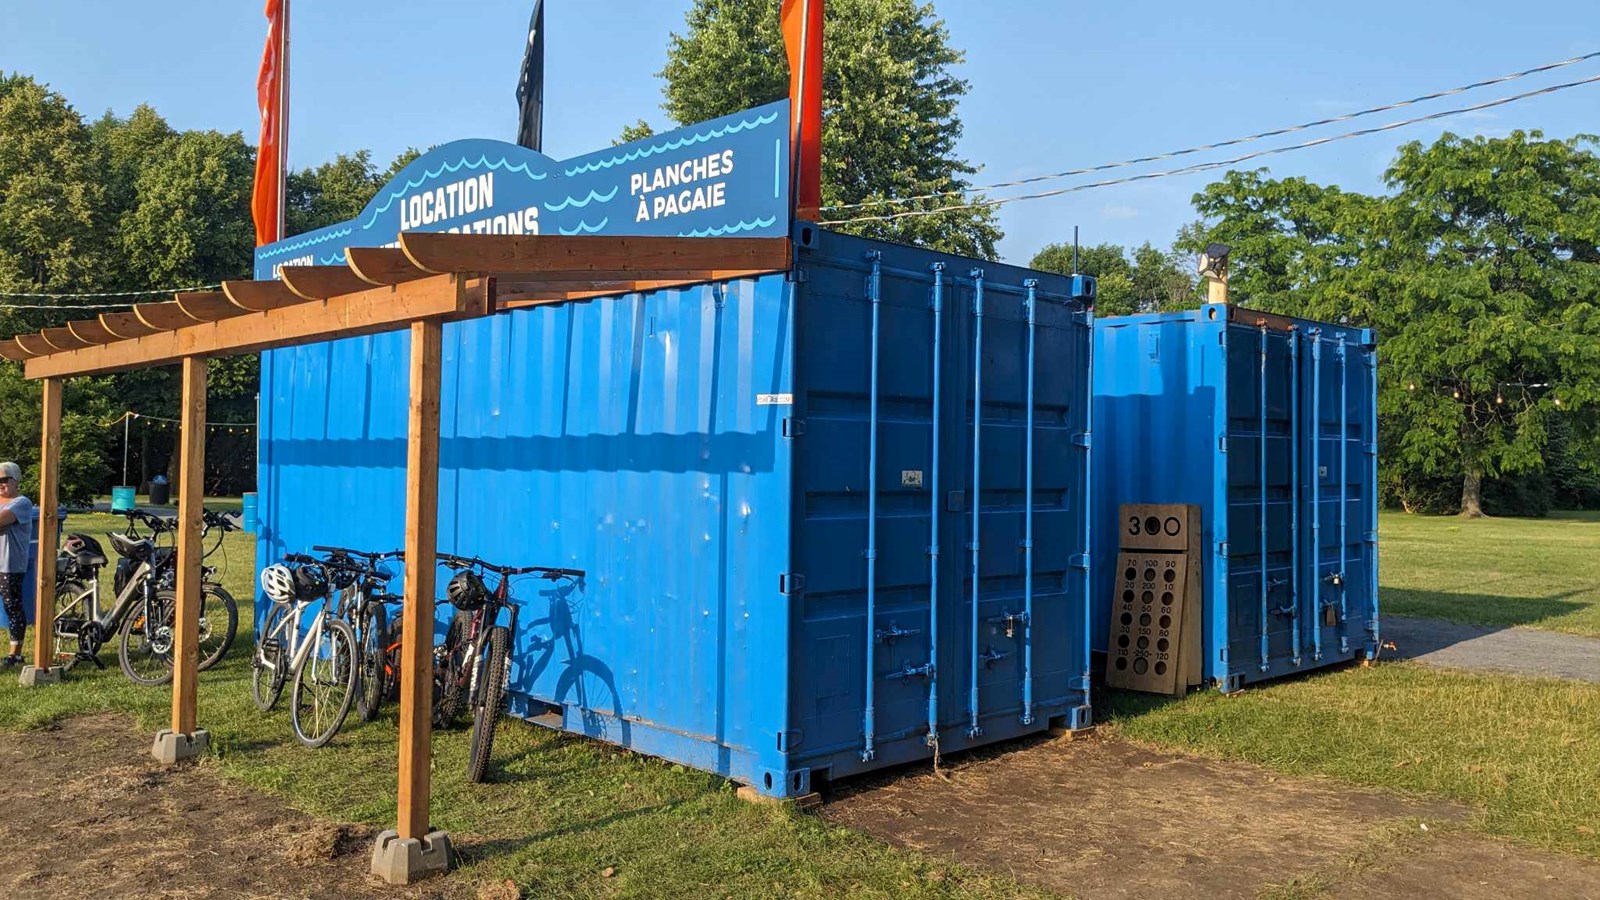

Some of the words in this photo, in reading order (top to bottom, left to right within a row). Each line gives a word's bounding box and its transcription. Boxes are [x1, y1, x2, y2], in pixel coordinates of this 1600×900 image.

[631, 149, 734, 196] PLANCHES
[400, 172, 494, 231] LOCATION
[636, 194, 650, 222] À
[653, 182, 726, 219] PAGAIE
[1129, 516, 1181, 536] 300
[1127, 559, 1137, 567] 70
[1125, 581, 1135, 589] 20
[1142, 582, 1156, 590] 200
[1156, 652, 1169, 660] 120
